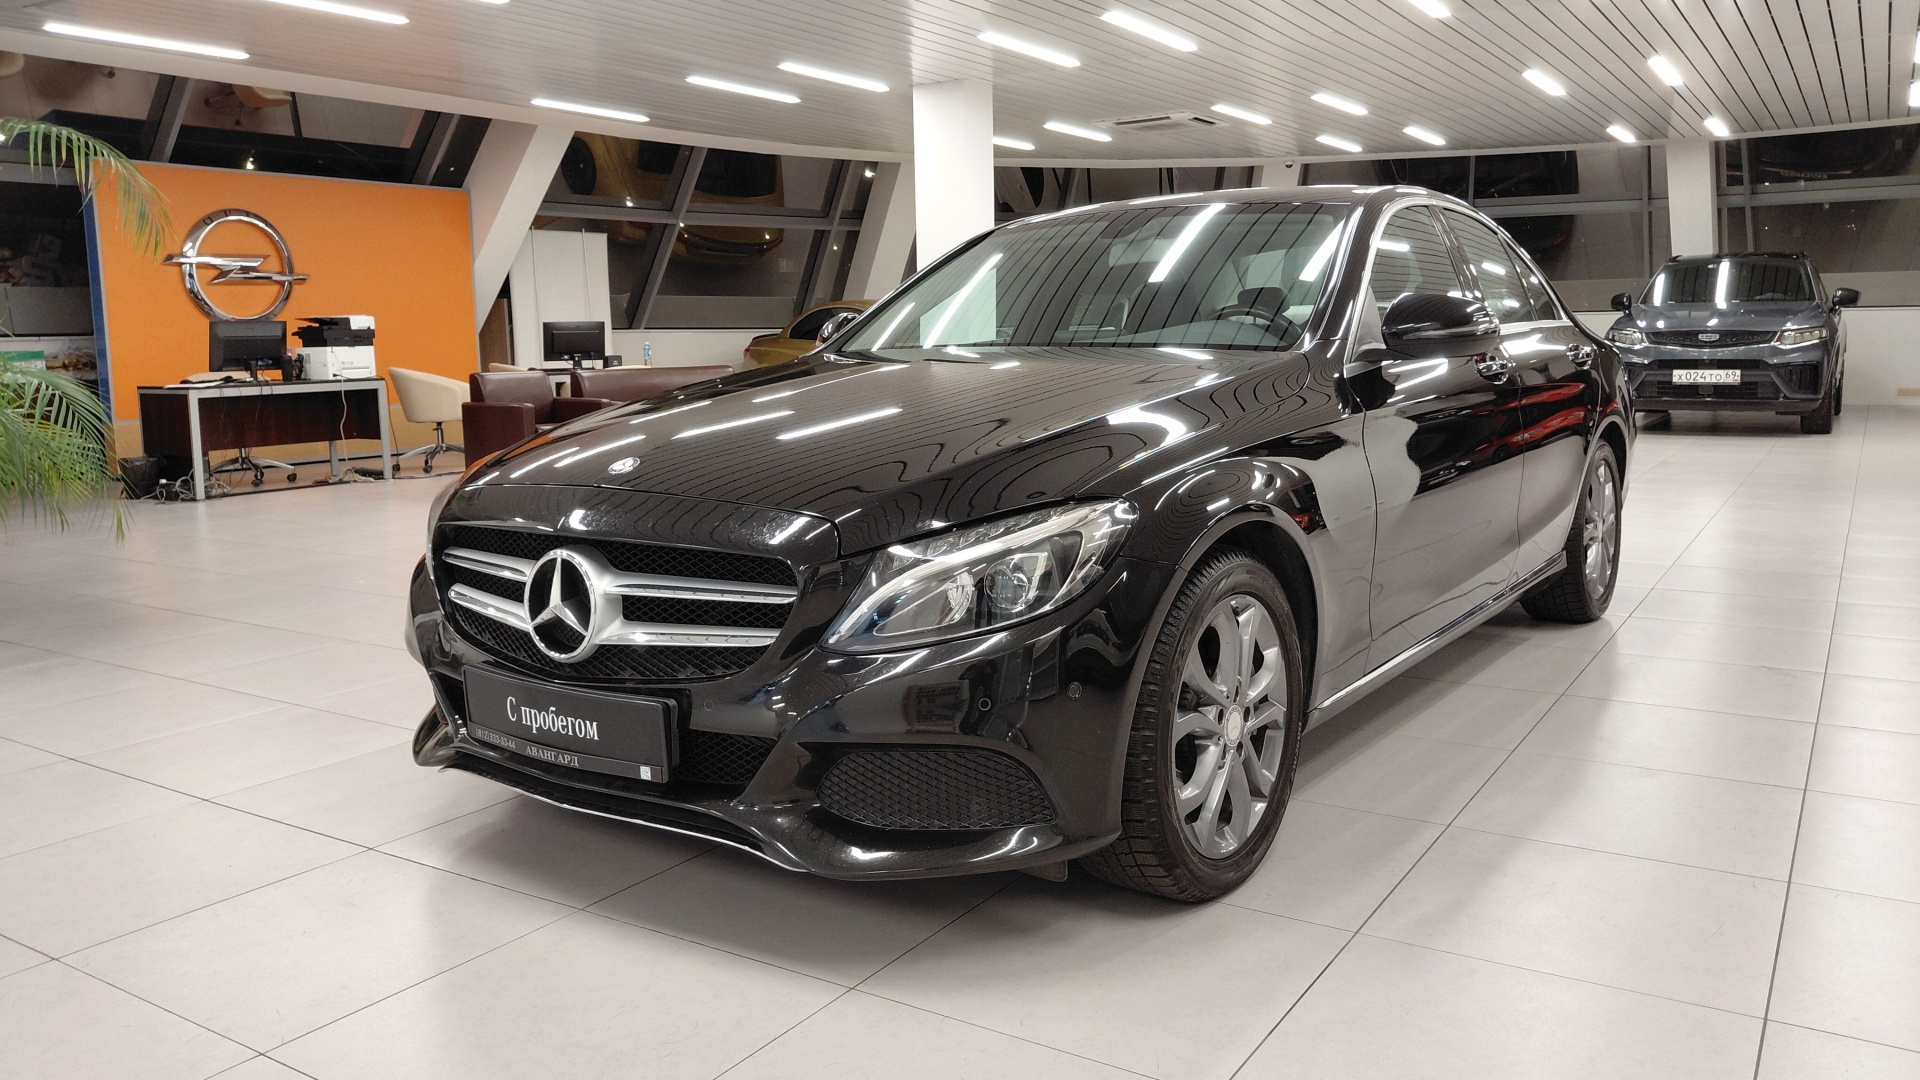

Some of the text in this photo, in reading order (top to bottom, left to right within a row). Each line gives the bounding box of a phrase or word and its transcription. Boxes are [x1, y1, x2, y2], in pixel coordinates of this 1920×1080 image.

[506, 696, 600, 741] С пробегом
[526, 746, 579, 767] АВАНГАРД
